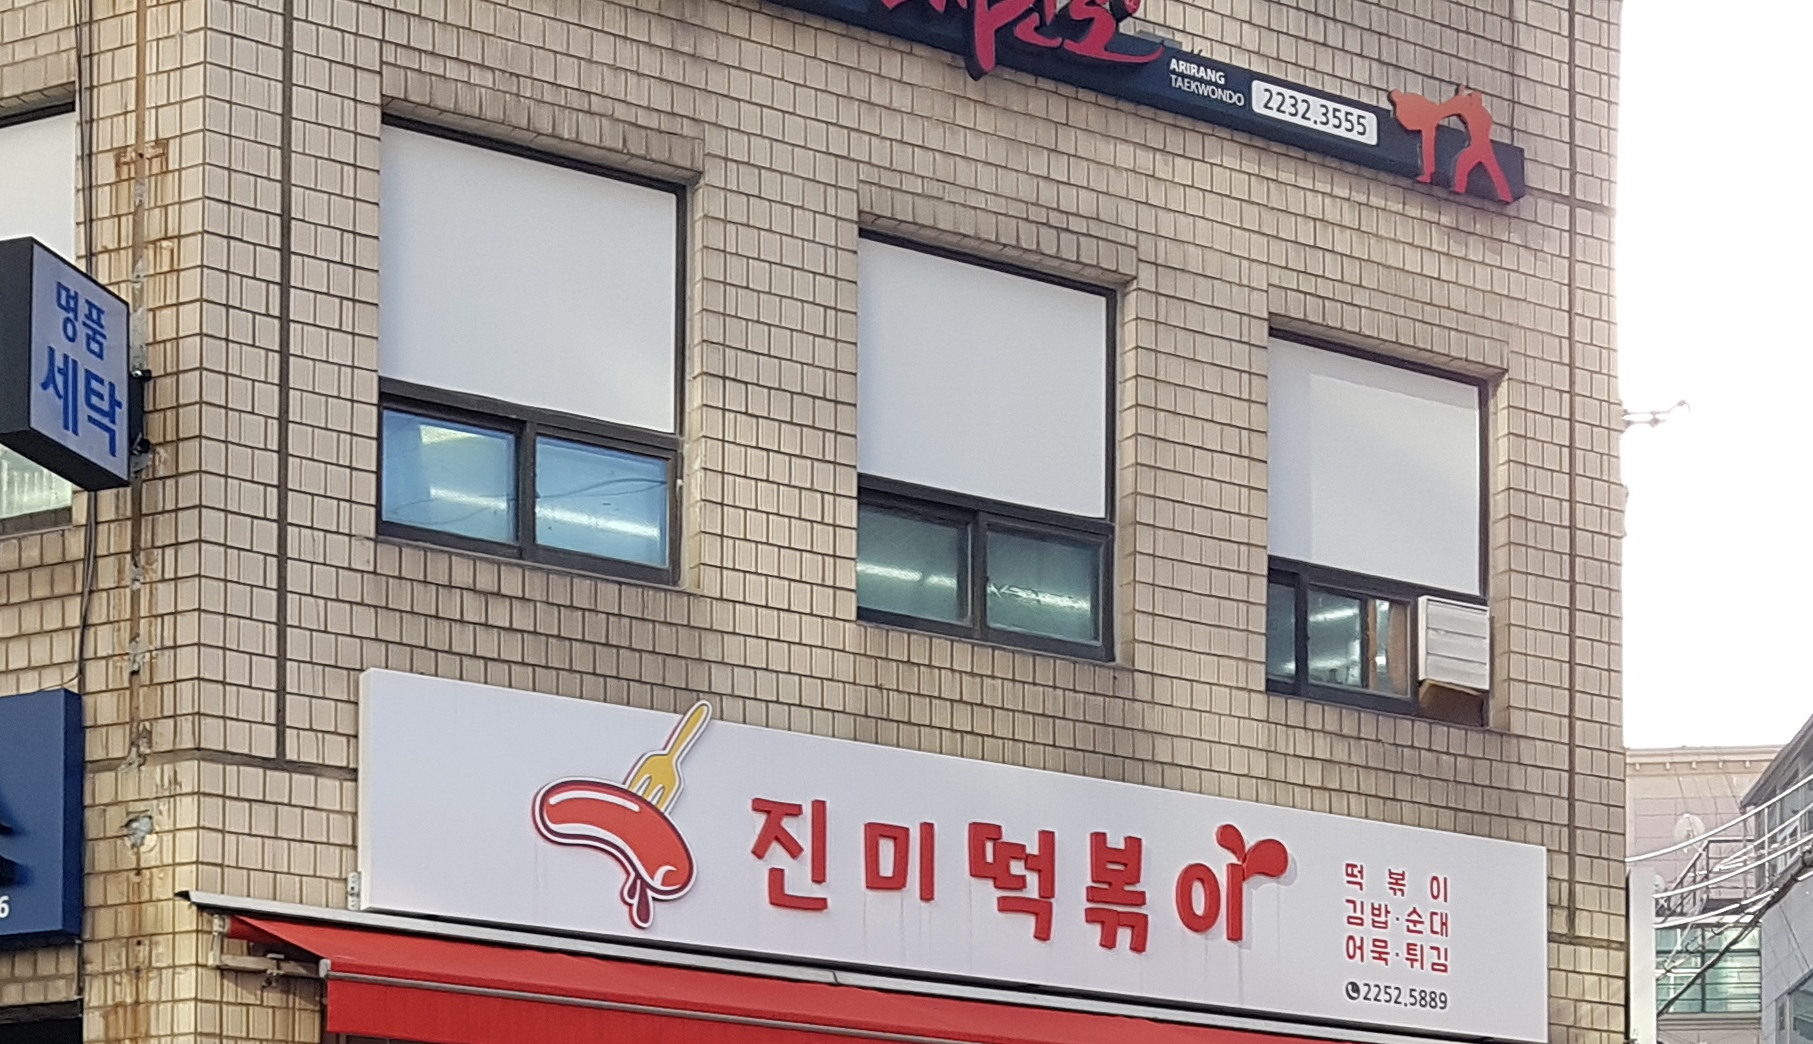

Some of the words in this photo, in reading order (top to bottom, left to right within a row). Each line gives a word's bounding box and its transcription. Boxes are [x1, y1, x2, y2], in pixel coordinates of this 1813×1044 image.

[1169, 58, 1226, 85] ARIRANG
[1170, 74, 1245, 107] TAEKWONDO
[1263, 88, 1367, 136] 2232.3555
[56, 281, 107, 361] 명품
[41, 346, 122, 457] 세탁
[1362, 983, 1448, 1010] 2252.5889
